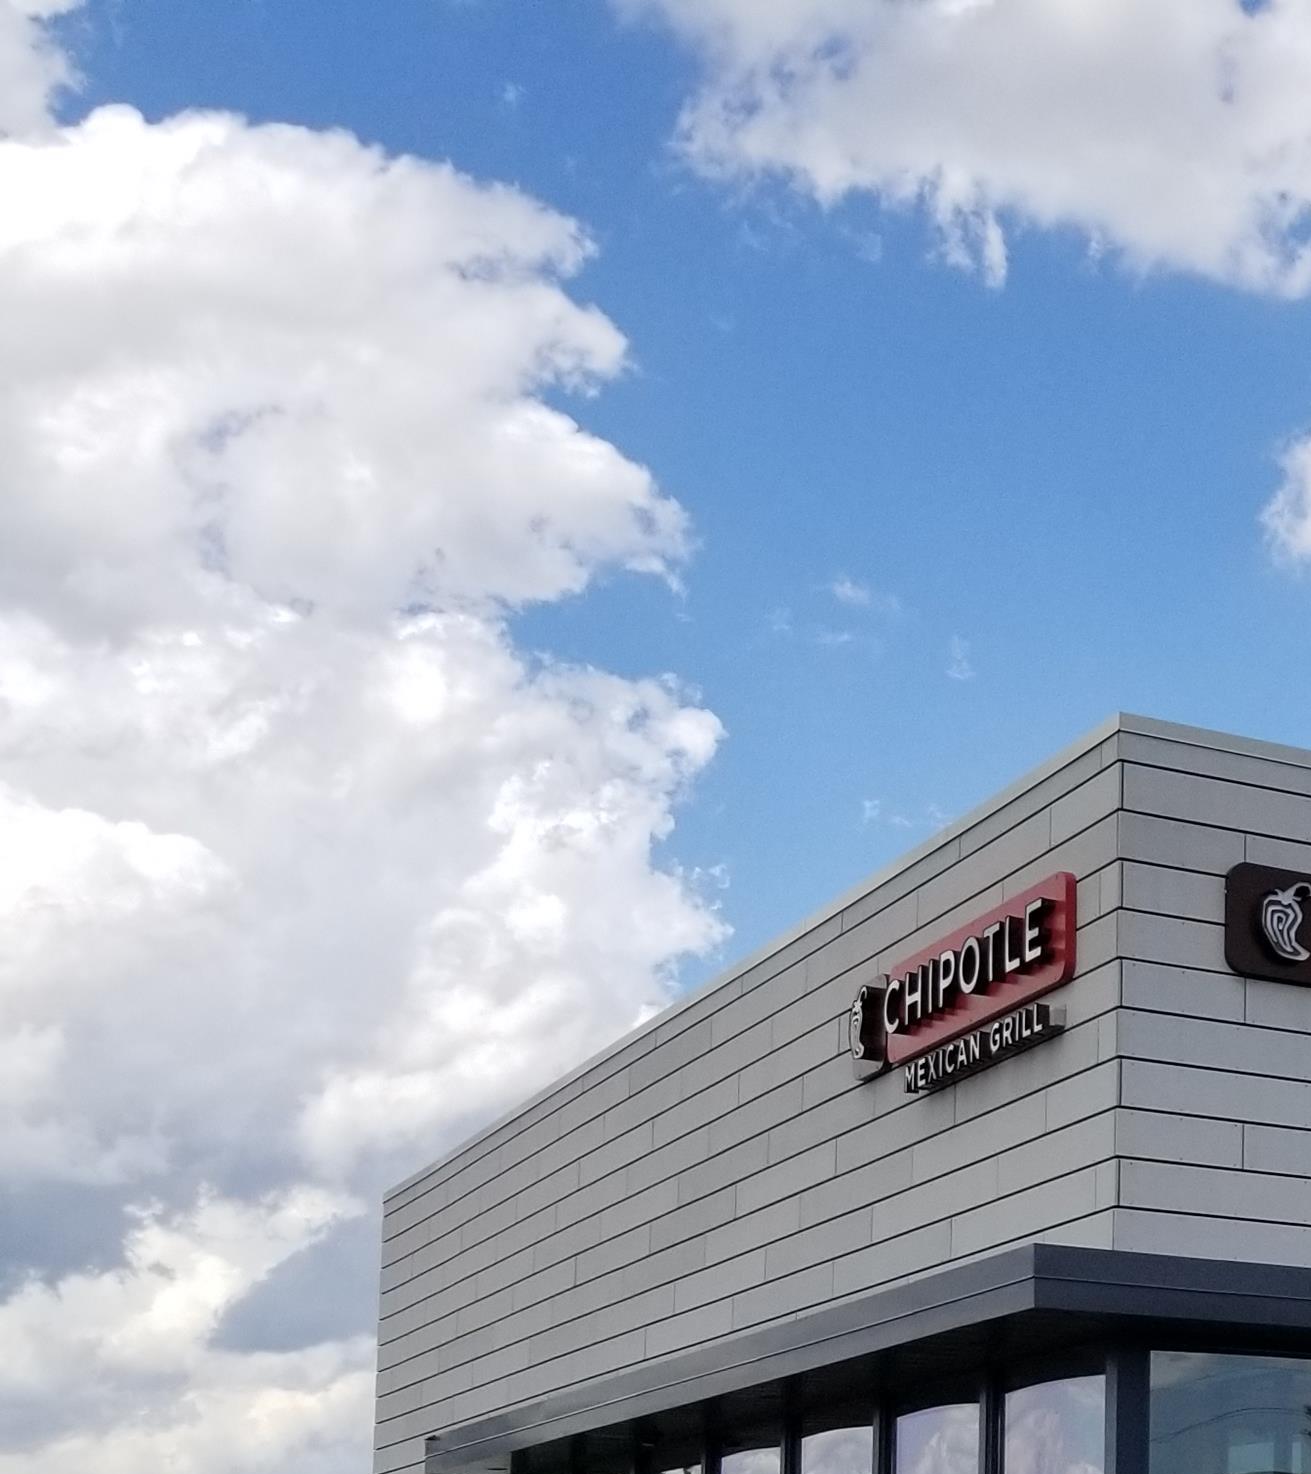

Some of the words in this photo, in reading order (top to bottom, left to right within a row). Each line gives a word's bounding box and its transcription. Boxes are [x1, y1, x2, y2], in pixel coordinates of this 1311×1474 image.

[884, 897, 1046, 1034] CHIPOTLE
[904, 1031, 982, 1092] MEXICAN
[989, 1003, 1045, 1052] GRILL
